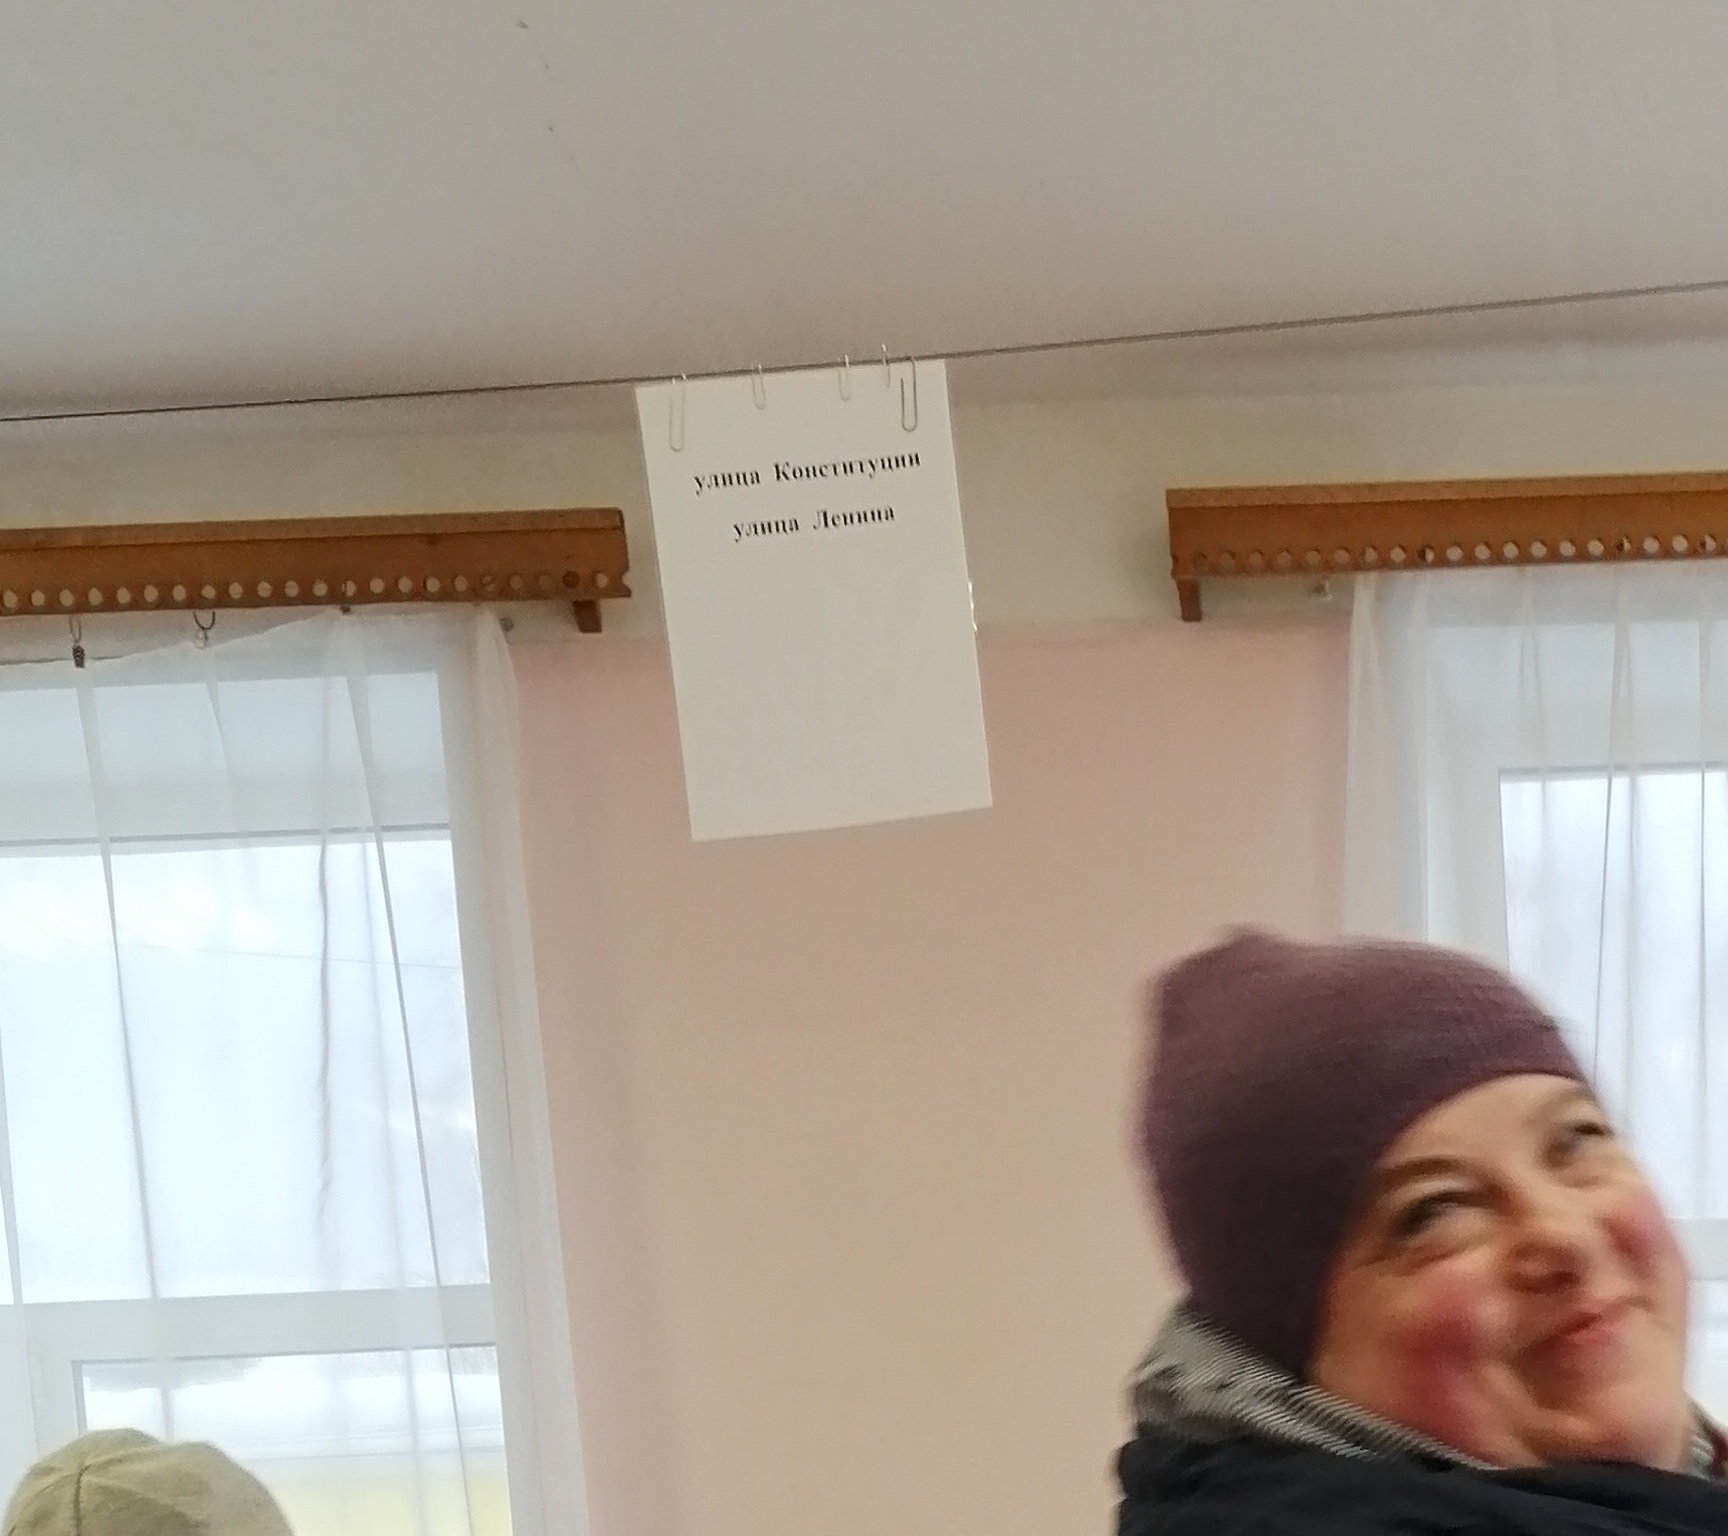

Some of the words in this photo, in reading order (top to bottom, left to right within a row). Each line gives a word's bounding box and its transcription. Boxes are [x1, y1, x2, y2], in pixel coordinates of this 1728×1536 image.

[694, 469, 761, 496] улица
[773, 452, 921, 482] Конституции
[733, 517, 800, 543] улица
[812, 506, 895, 531] Ленина
